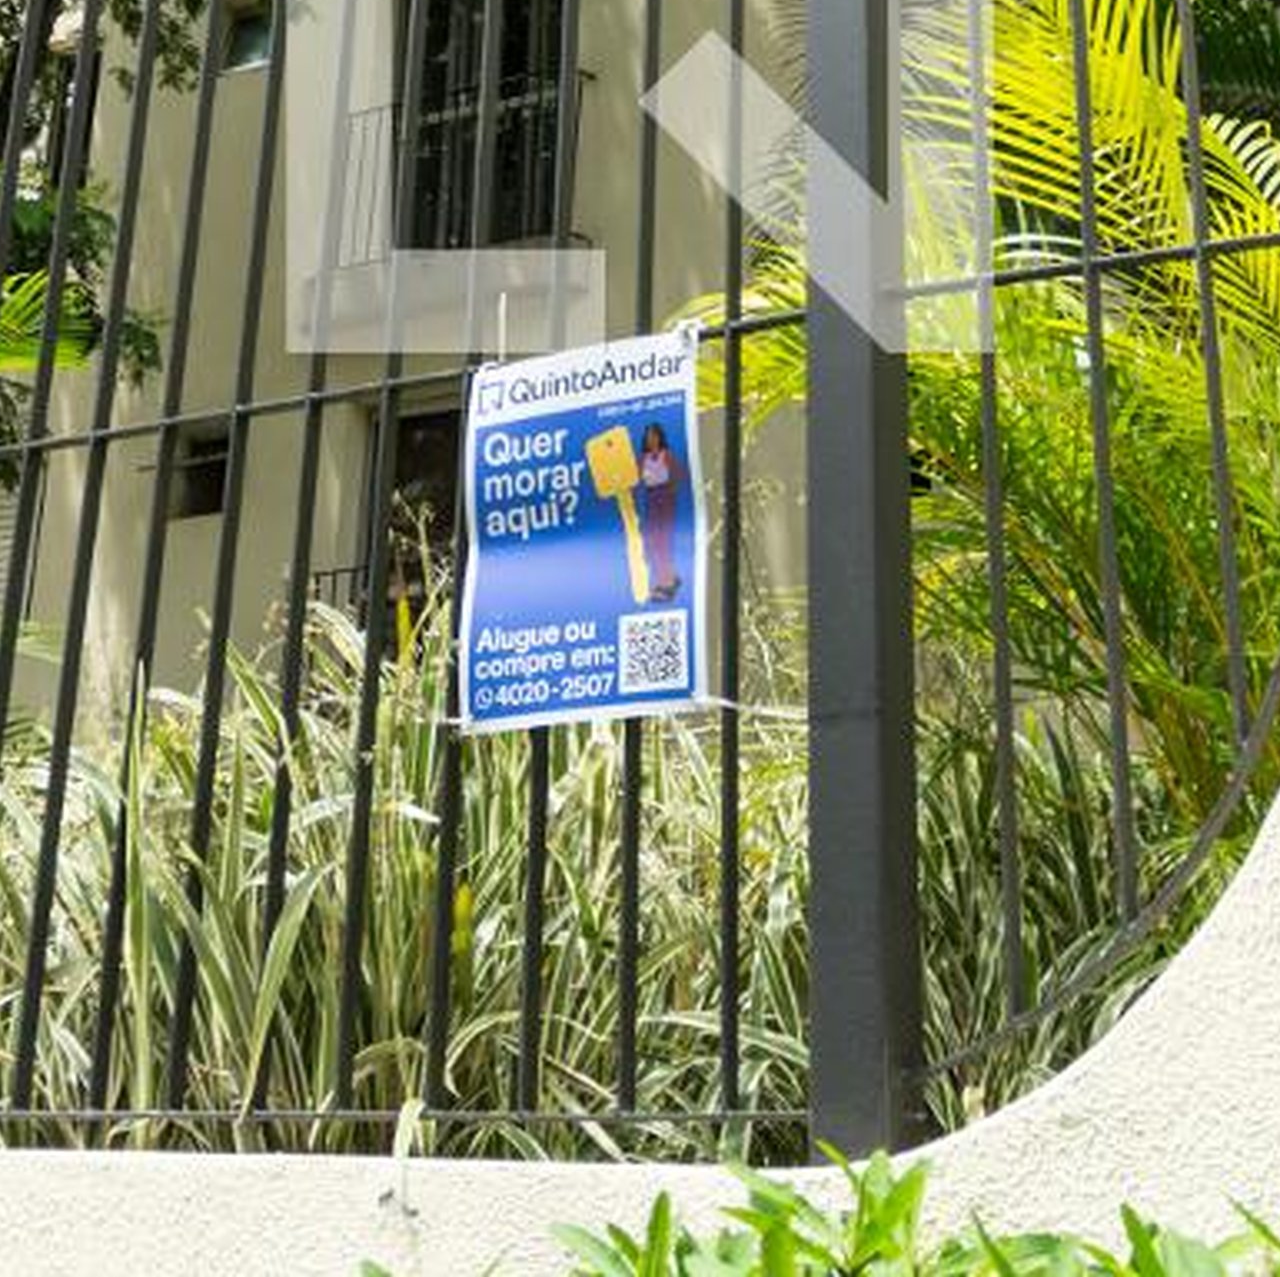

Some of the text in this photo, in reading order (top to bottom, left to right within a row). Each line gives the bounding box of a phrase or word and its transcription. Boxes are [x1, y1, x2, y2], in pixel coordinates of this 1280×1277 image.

[508, 353, 686, 404] QuintoAndar
[483, 428, 568, 467] Quer
[483, 460, 586, 502] morar
[485, 491, 579, 540] aqui?
[475, 621, 596, 654] Alugue ou
[474, 644, 616, 680] compre em:
